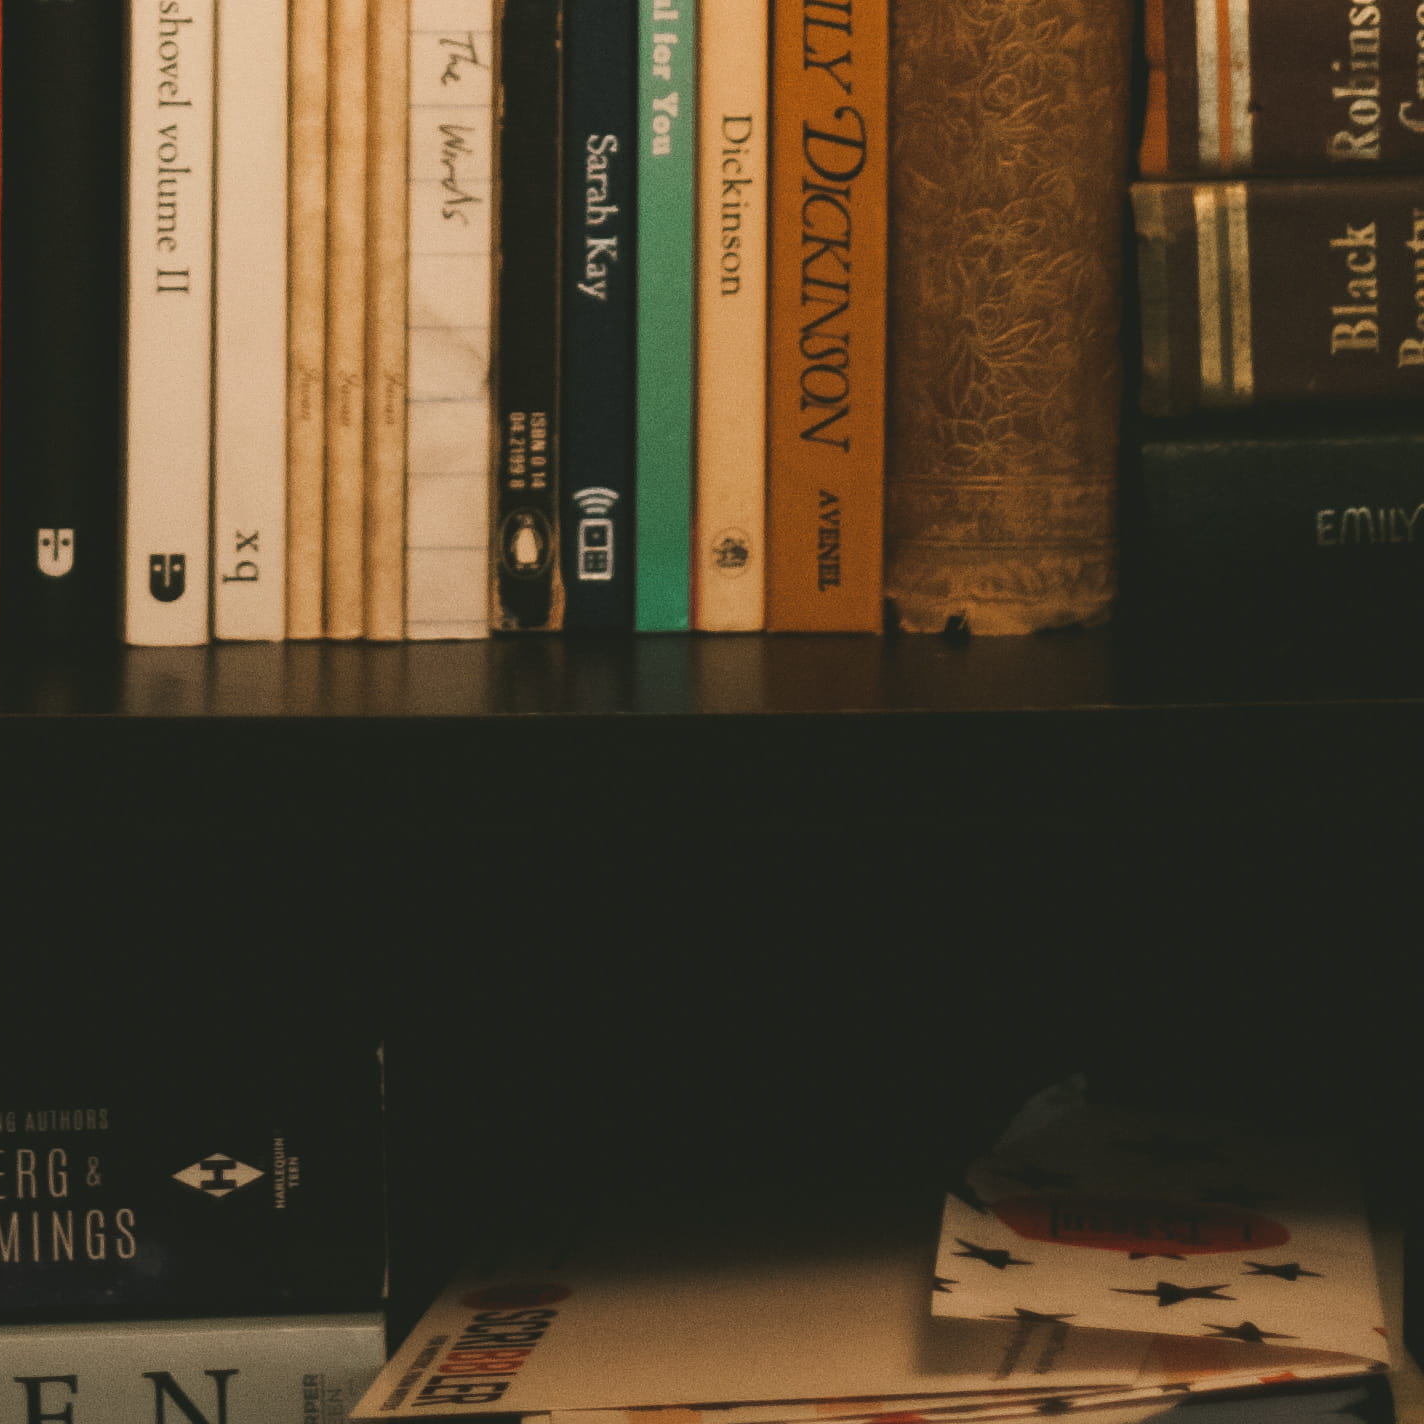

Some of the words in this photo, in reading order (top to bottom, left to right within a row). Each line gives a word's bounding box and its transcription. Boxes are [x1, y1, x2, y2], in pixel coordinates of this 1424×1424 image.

[156, 0, 194, 111] shovel
[652, 32, 680, 80] for
[652, 87, 681, 156] You
[156, 123, 193, 252] volume
[438, 124, 482, 226] Words
[582, 133, 619, 225] Sarah
[720, 114, 755, 297] Dickinson
[156, 266, 191, 295] II
[576, 237, 618, 300] Kay
[800, 104, 868, 453] DICKINSON
[1329, 220, 1380, 358] Black
[817, 488, 842, 593] AVENEL
[23, 1106, 111, 1135] AUTHORS
